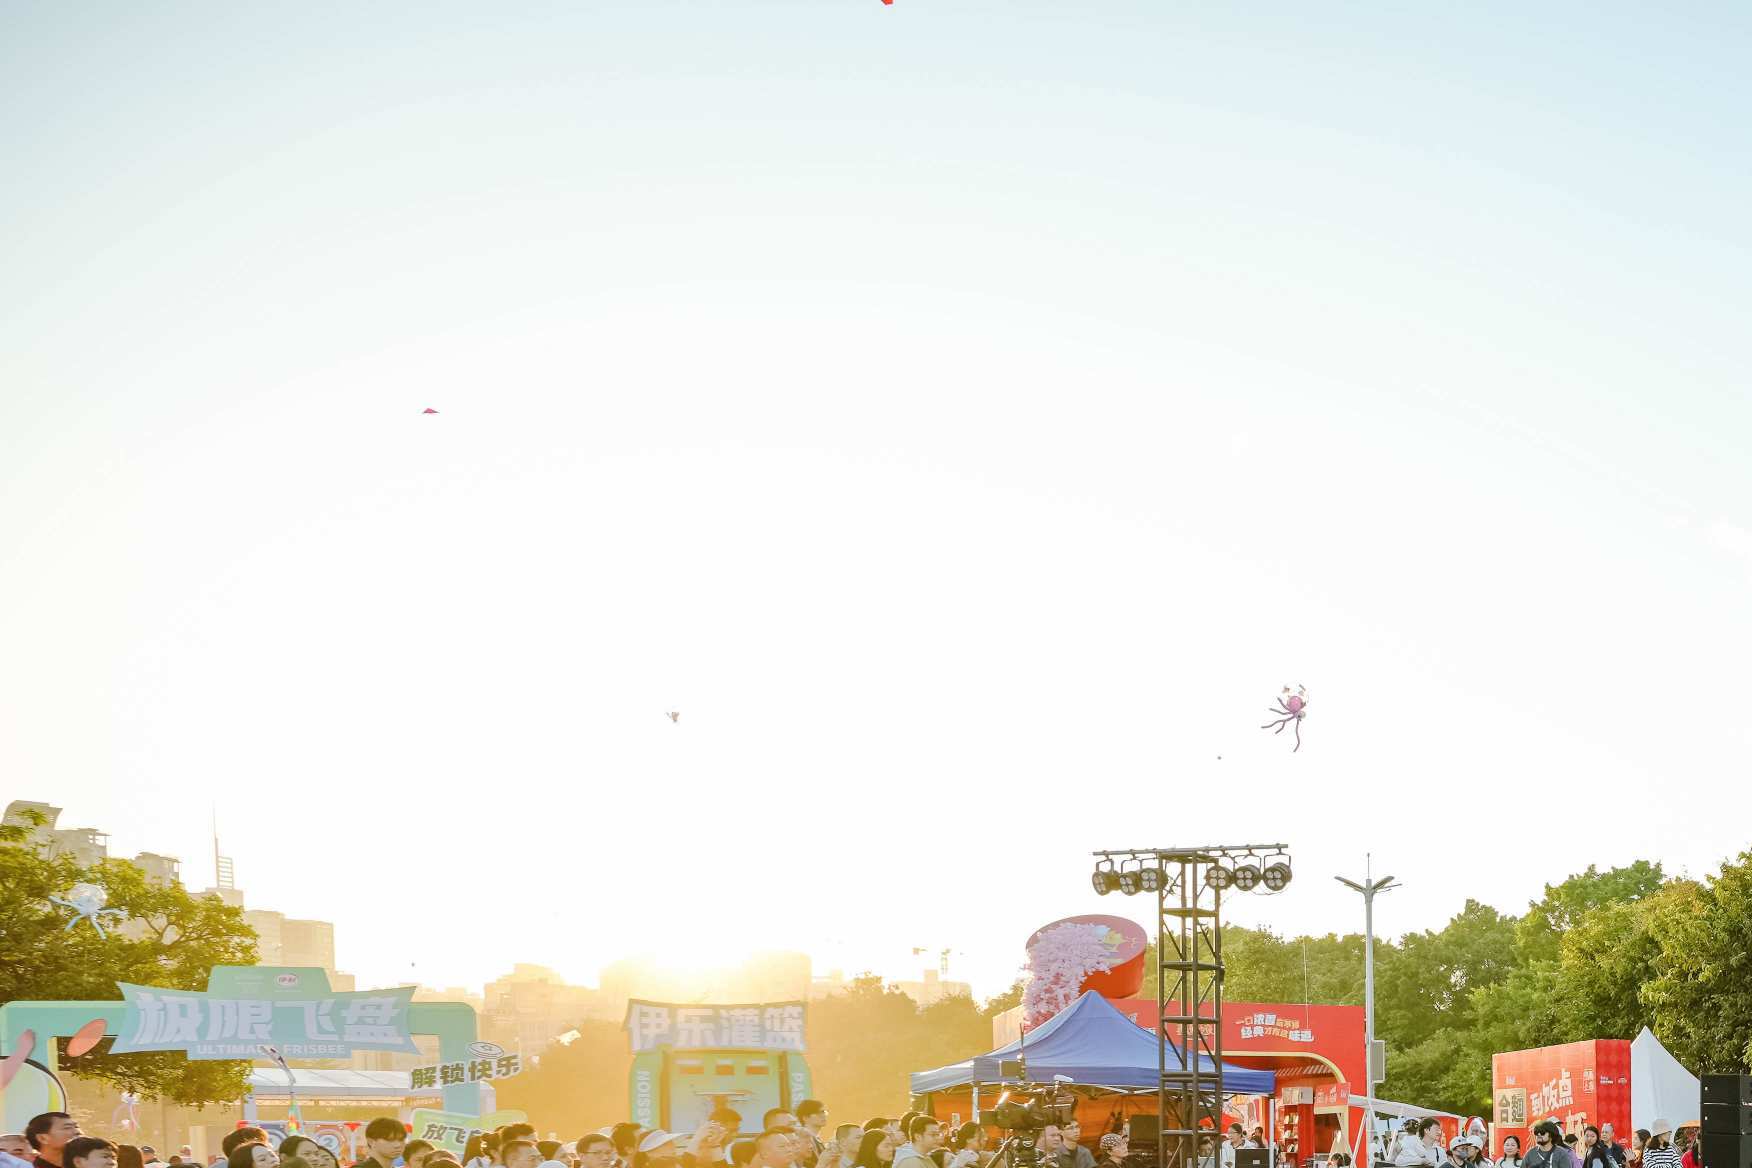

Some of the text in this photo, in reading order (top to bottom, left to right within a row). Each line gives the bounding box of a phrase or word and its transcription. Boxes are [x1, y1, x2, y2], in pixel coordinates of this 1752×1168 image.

[130, 992, 404, 1045] 极限飞盘
[628, 1004, 804, 1050] 伊乐灌篮
[282, 1043, 343, 1055] FRISBEE
[411, 1054, 520, 1090] 解锁快乐
[1530, 1068, 1574, 1117] 到饭点
